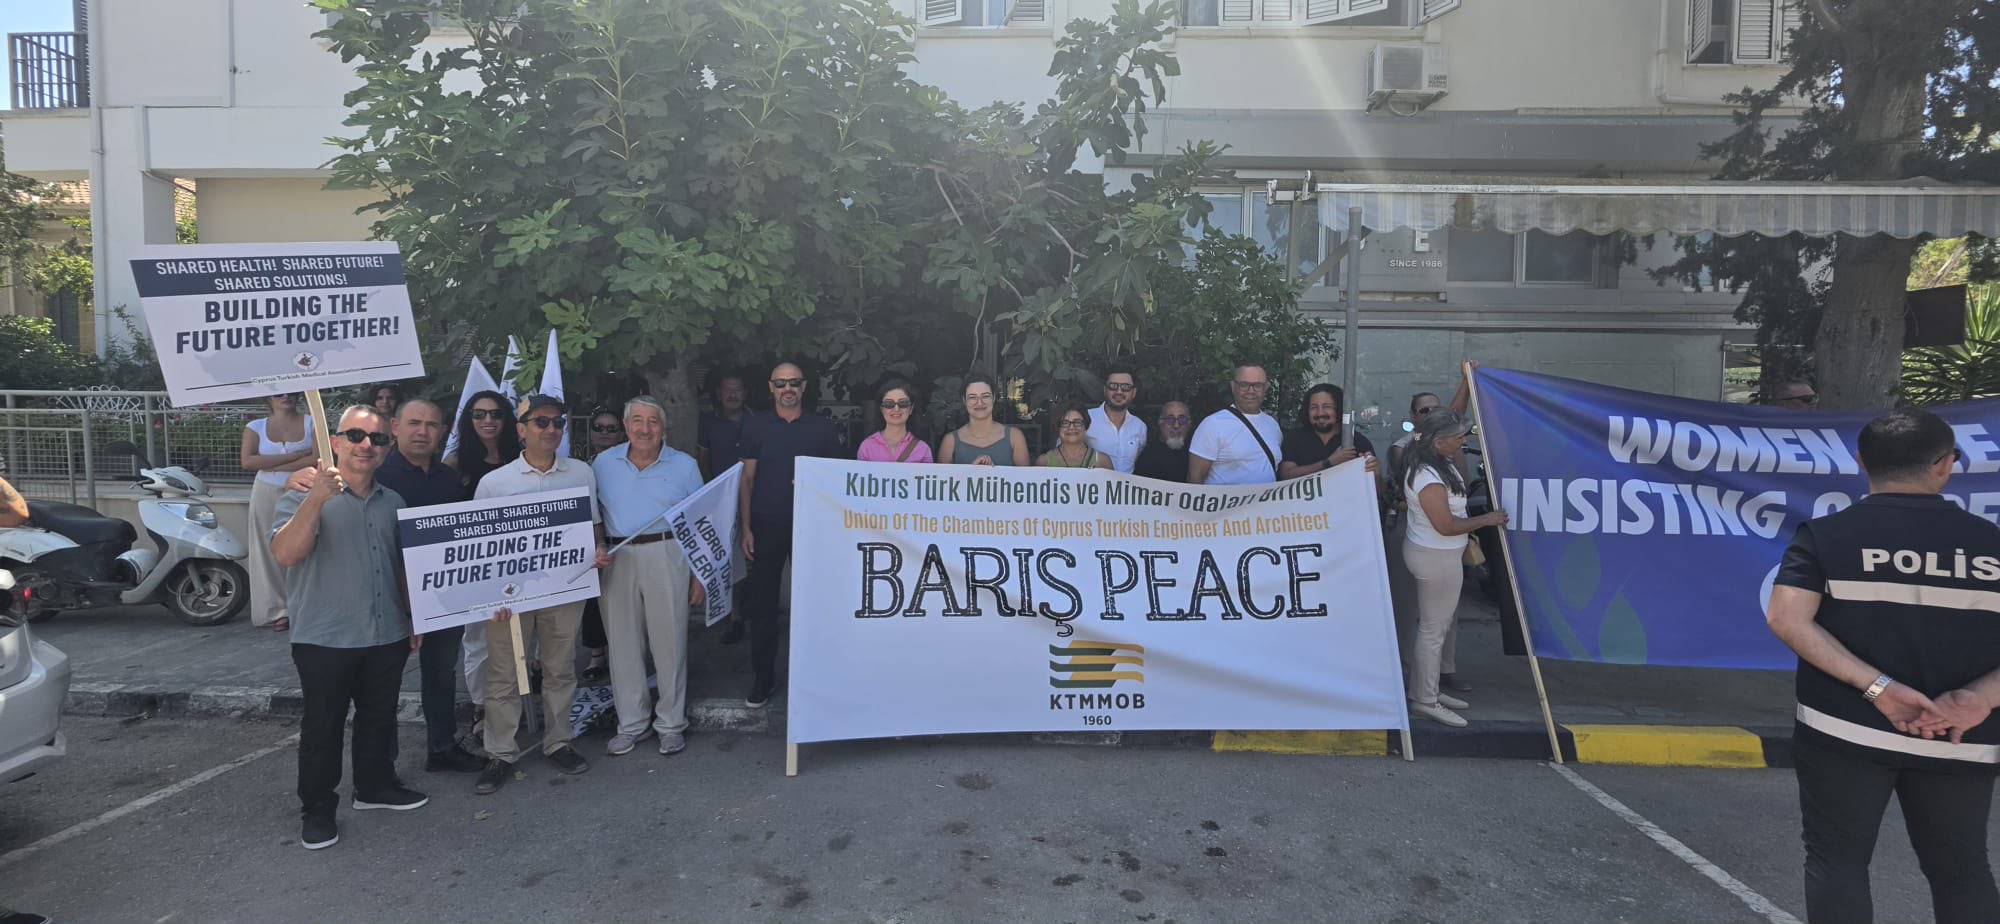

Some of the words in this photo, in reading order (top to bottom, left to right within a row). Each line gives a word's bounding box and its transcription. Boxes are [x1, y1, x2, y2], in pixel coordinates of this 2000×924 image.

[155, 260, 217, 275] SHARED
[219, 258, 278, 273] HEALTH!
[282, 257, 333, 271] SHARED
[336, 255, 384, 270] FUTURE!
[1389, 259, 1417, 268] SINCE
[214, 276, 271, 291] SHARED
[273, 273, 348, 288] SOLUTIONS!
[205, 295, 322, 323] BUILDING
[327, 293, 368, 313] THE
[176, 325, 276, 354] FUTURE
[282, 316, 399, 345] TOGETHER!
[1608, 415, 1860, 475] WOMEN
[845, 472, 909, 499] Kıbrıs
[914, 474, 961, 502] Türk
[966, 476, 1071, 505] Mühendis
[1076, 483, 1099, 505] ve
[1105, 480, 1174, 507] Mimar
[415, 516, 457, 530] SHARED
[458, 509, 499, 525] HEALTH!
[503, 505, 540, 519] SHARED
[541, 499, 578, 513] FUTURE!
[1501, 477, 1787, 539] INSISTING
[453, 524, 493, 539] SHARED
[494, 517, 549, 533] SOLUTIONS!
[694, 516, 727, 562] KIBRIS
[843, 509, 888, 531] Union
[892, 512, 908, 530] Of
[911, 513, 938, 533] The
[942, 514, 1019, 536] Chambers
[1022, 517, 1039, 536] Of
[1042, 517, 1093, 540] Cyprus
[1096, 518, 1149, 539] Turkish
[1153, 518, 1219, 541] Engineer
[1222, 515, 1252, 537] And
[1255, 511, 1329, 534] Architect
[444, 536, 528, 565] BUILDING
[532, 530, 563, 550] THE
[672, 511, 715, 581] TABİPLERİ
[422, 563, 492, 592] FUTURE
[497, 547, 586, 578] TOGETHER!
[1861, 548, 2000, 581] POLİS
[855, 543, 1084, 637] BARIŞ
[1095, 543, 1328, 621] PEACE
[1049, 693, 1145, 710] KTMMOB
[1082, 715, 1112, 725] 1960
